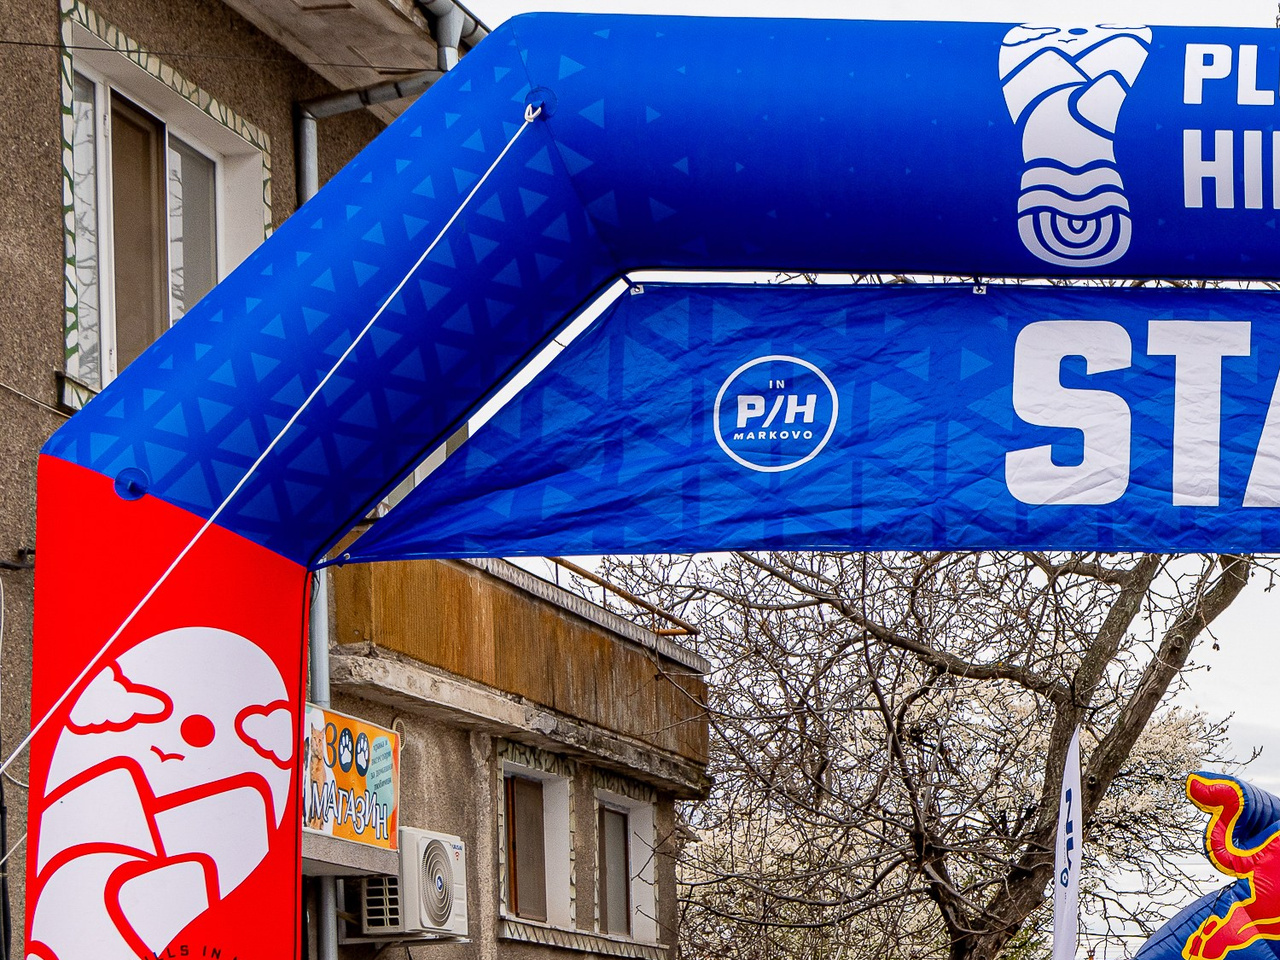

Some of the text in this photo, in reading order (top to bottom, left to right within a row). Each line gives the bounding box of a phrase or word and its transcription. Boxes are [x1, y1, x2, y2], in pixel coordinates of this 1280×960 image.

[769, 379, 785, 389] IN
[736, 393, 818, 428] P/H
[733, 430, 813, 440] MARKOVO
[310, 779, 389, 840] МАГАЗИН
[202, 945, 222, 960] IN
